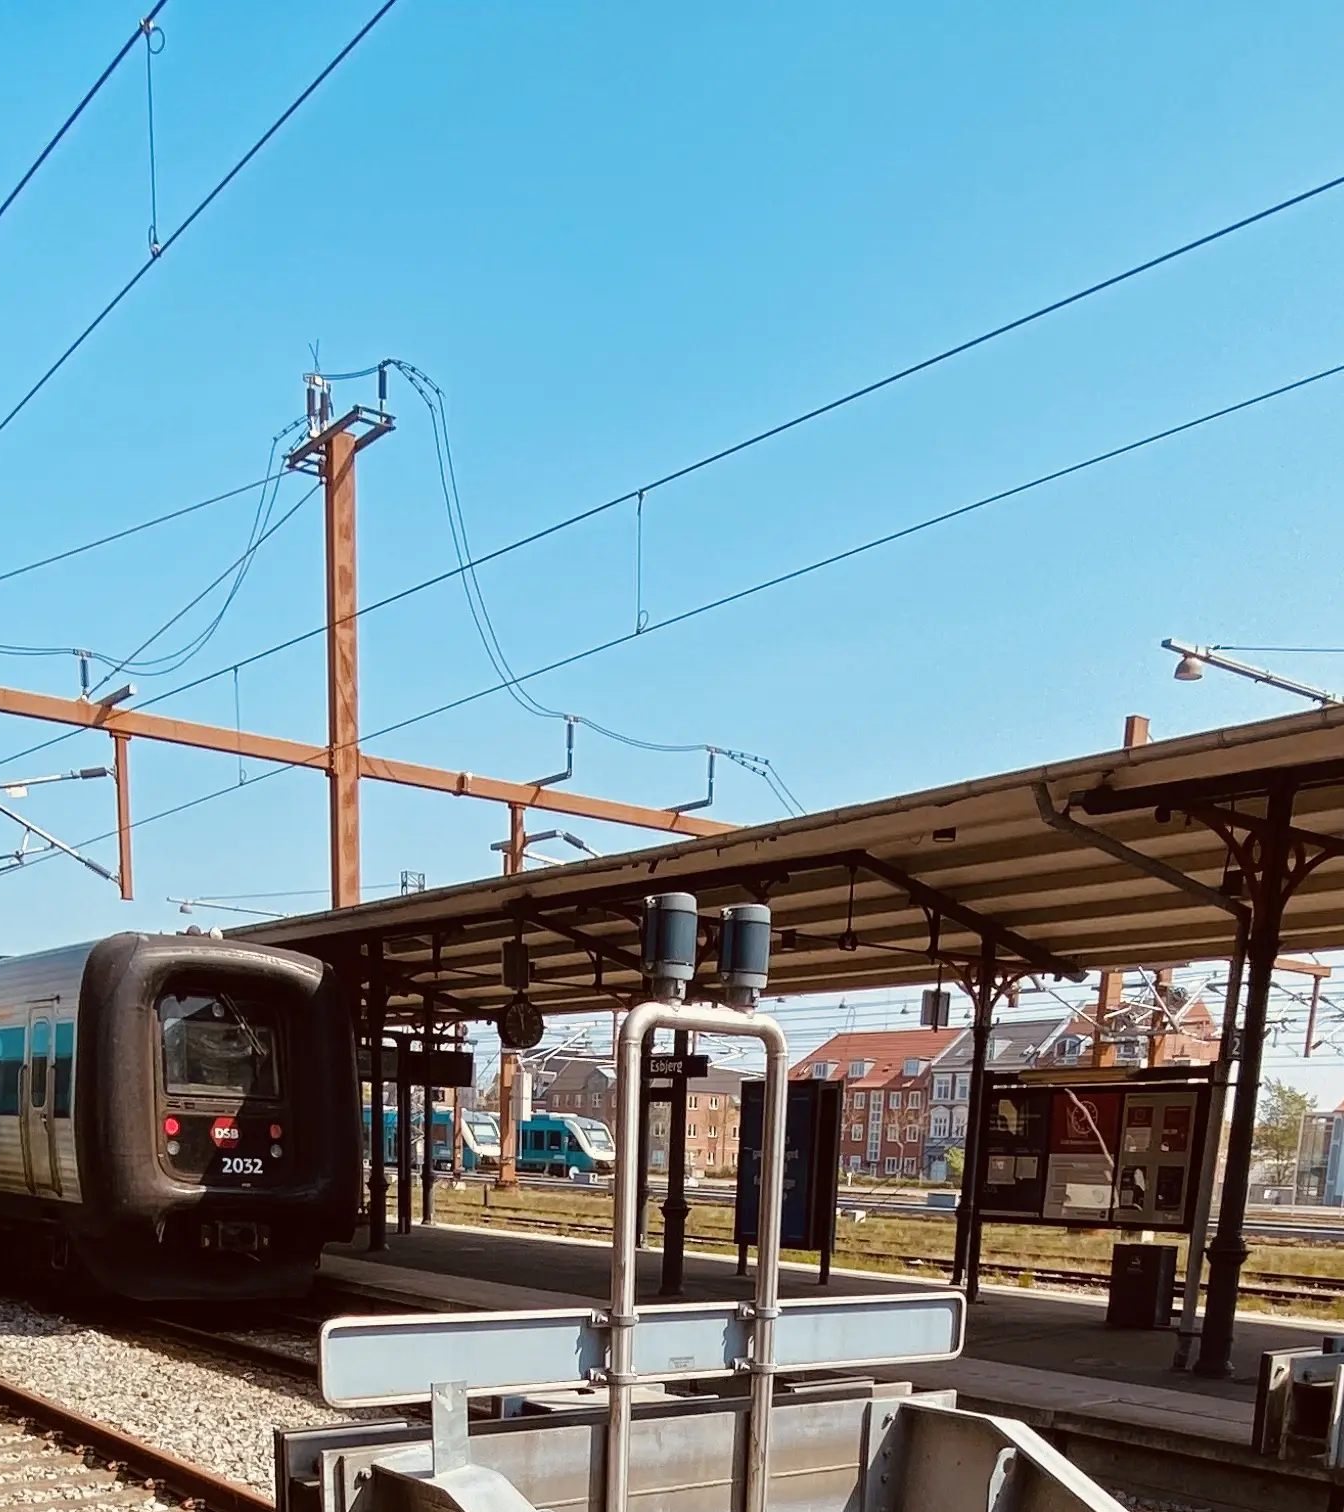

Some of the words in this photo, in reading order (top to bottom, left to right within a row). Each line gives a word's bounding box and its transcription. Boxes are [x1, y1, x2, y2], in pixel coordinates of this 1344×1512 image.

[1232, 1037, 1241, 1056] 2
[650, 1059, 683, 1074] Esbjerg
[214, 1127, 240, 1140] DSB
[221, 1157, 264, 1175] 2032
